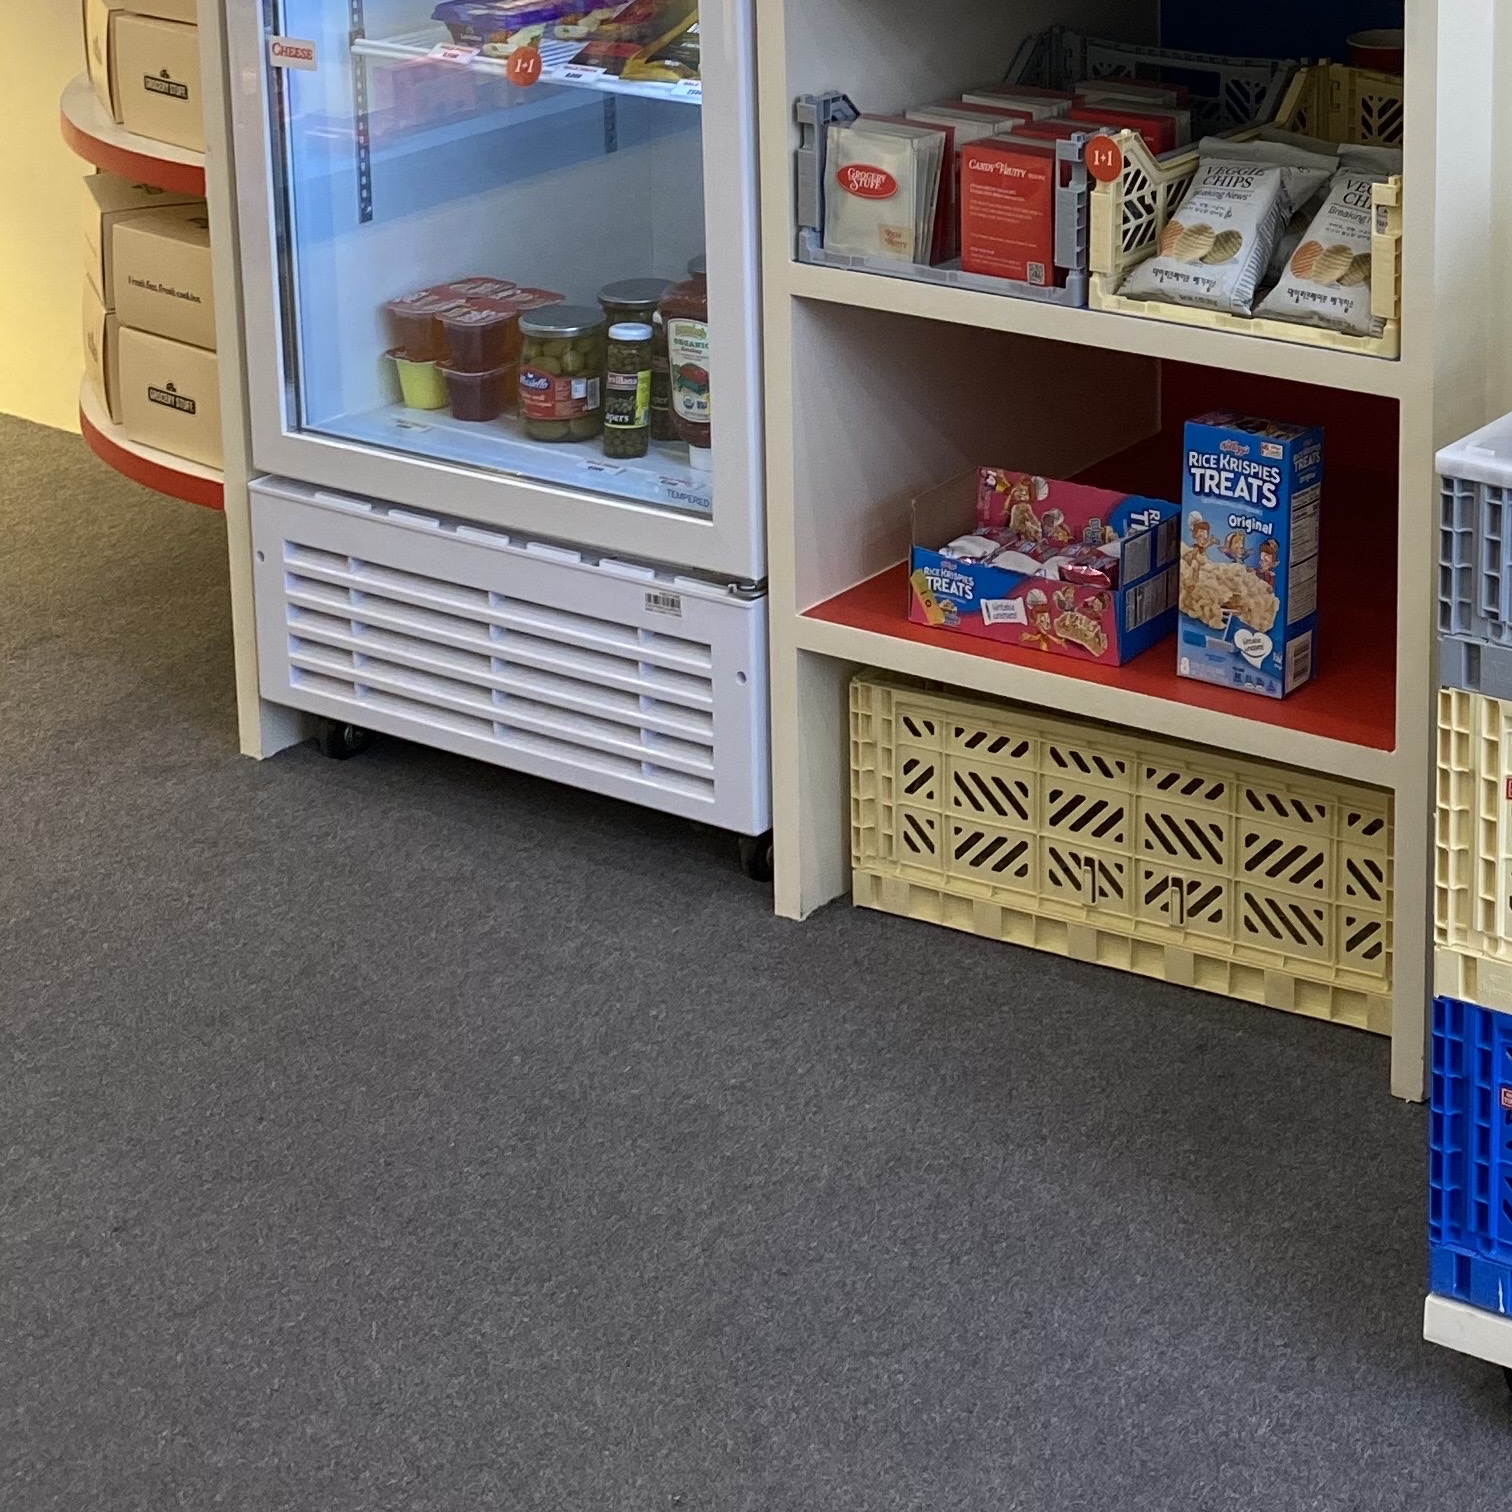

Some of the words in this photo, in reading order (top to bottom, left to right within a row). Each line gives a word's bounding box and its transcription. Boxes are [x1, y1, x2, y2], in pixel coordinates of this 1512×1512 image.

[272, 42, 313, 61] CHEESE
[514, 57, 534, 74] 1+1
[1093, 149, 1113, 167] 1+1
[847, 168, 887, 185] GROCERY
[968, 159, 994, 175] CANDY
[995, 162, 1027, 179] FRUITY
[1207, 165, 1265, 177] VEGGIE
[849, 178, 883, 191] STUFF
[1202, 175, 1255, 189] CHIPS
[1328, 205, 1368, 224] Breaking
[1189, 451, 1218, 468] RICE
[1220, 453, 1281, 484] KRISPIES
[1190, 467, 1277, 508] TREATS
[667, 489, 710, 508] TEMPERED
[1228, 514, 1273, 535] Original
[924, 567, 939, 577] RICE
[940, 568, 974, 587] KRISPIES
[925, 576, 973, 600] TREATS
